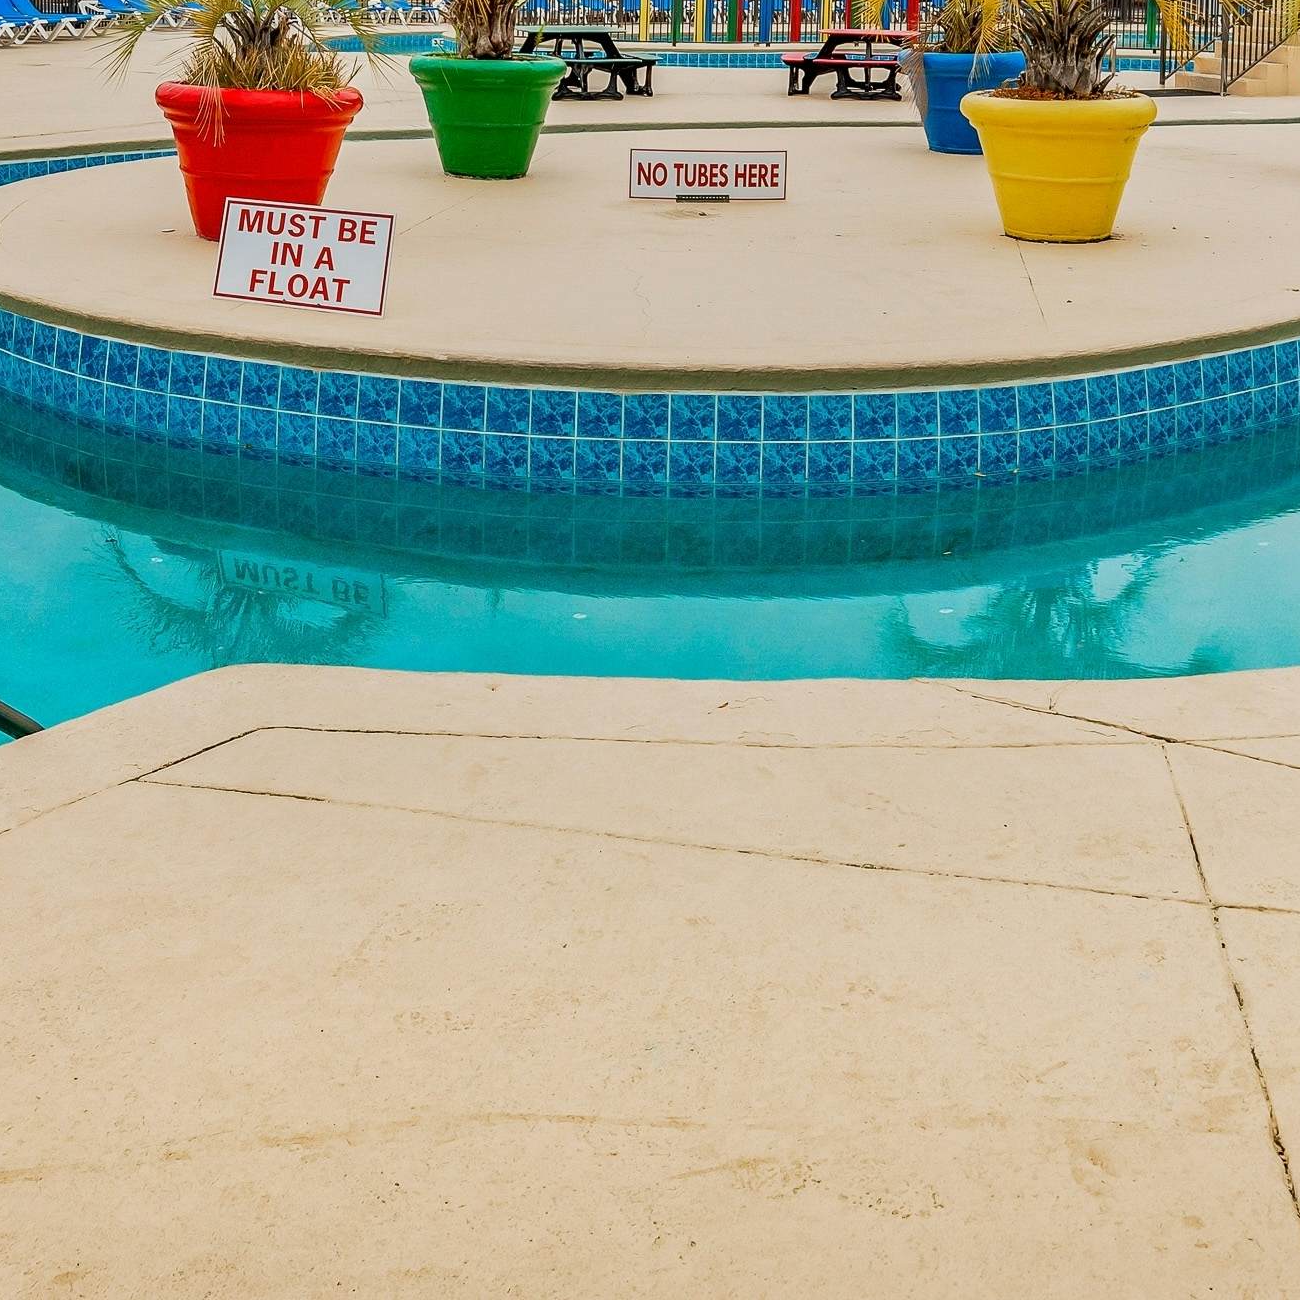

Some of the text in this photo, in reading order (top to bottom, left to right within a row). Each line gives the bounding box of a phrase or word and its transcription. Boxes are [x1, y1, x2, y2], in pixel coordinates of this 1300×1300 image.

[637, 162, 780, 188] NO TUBES HERE
[238, 208, 378, 245] MUST BE
[270, 241, 335, 272] IN A
[249, 269, 351, 303] FLOAT
